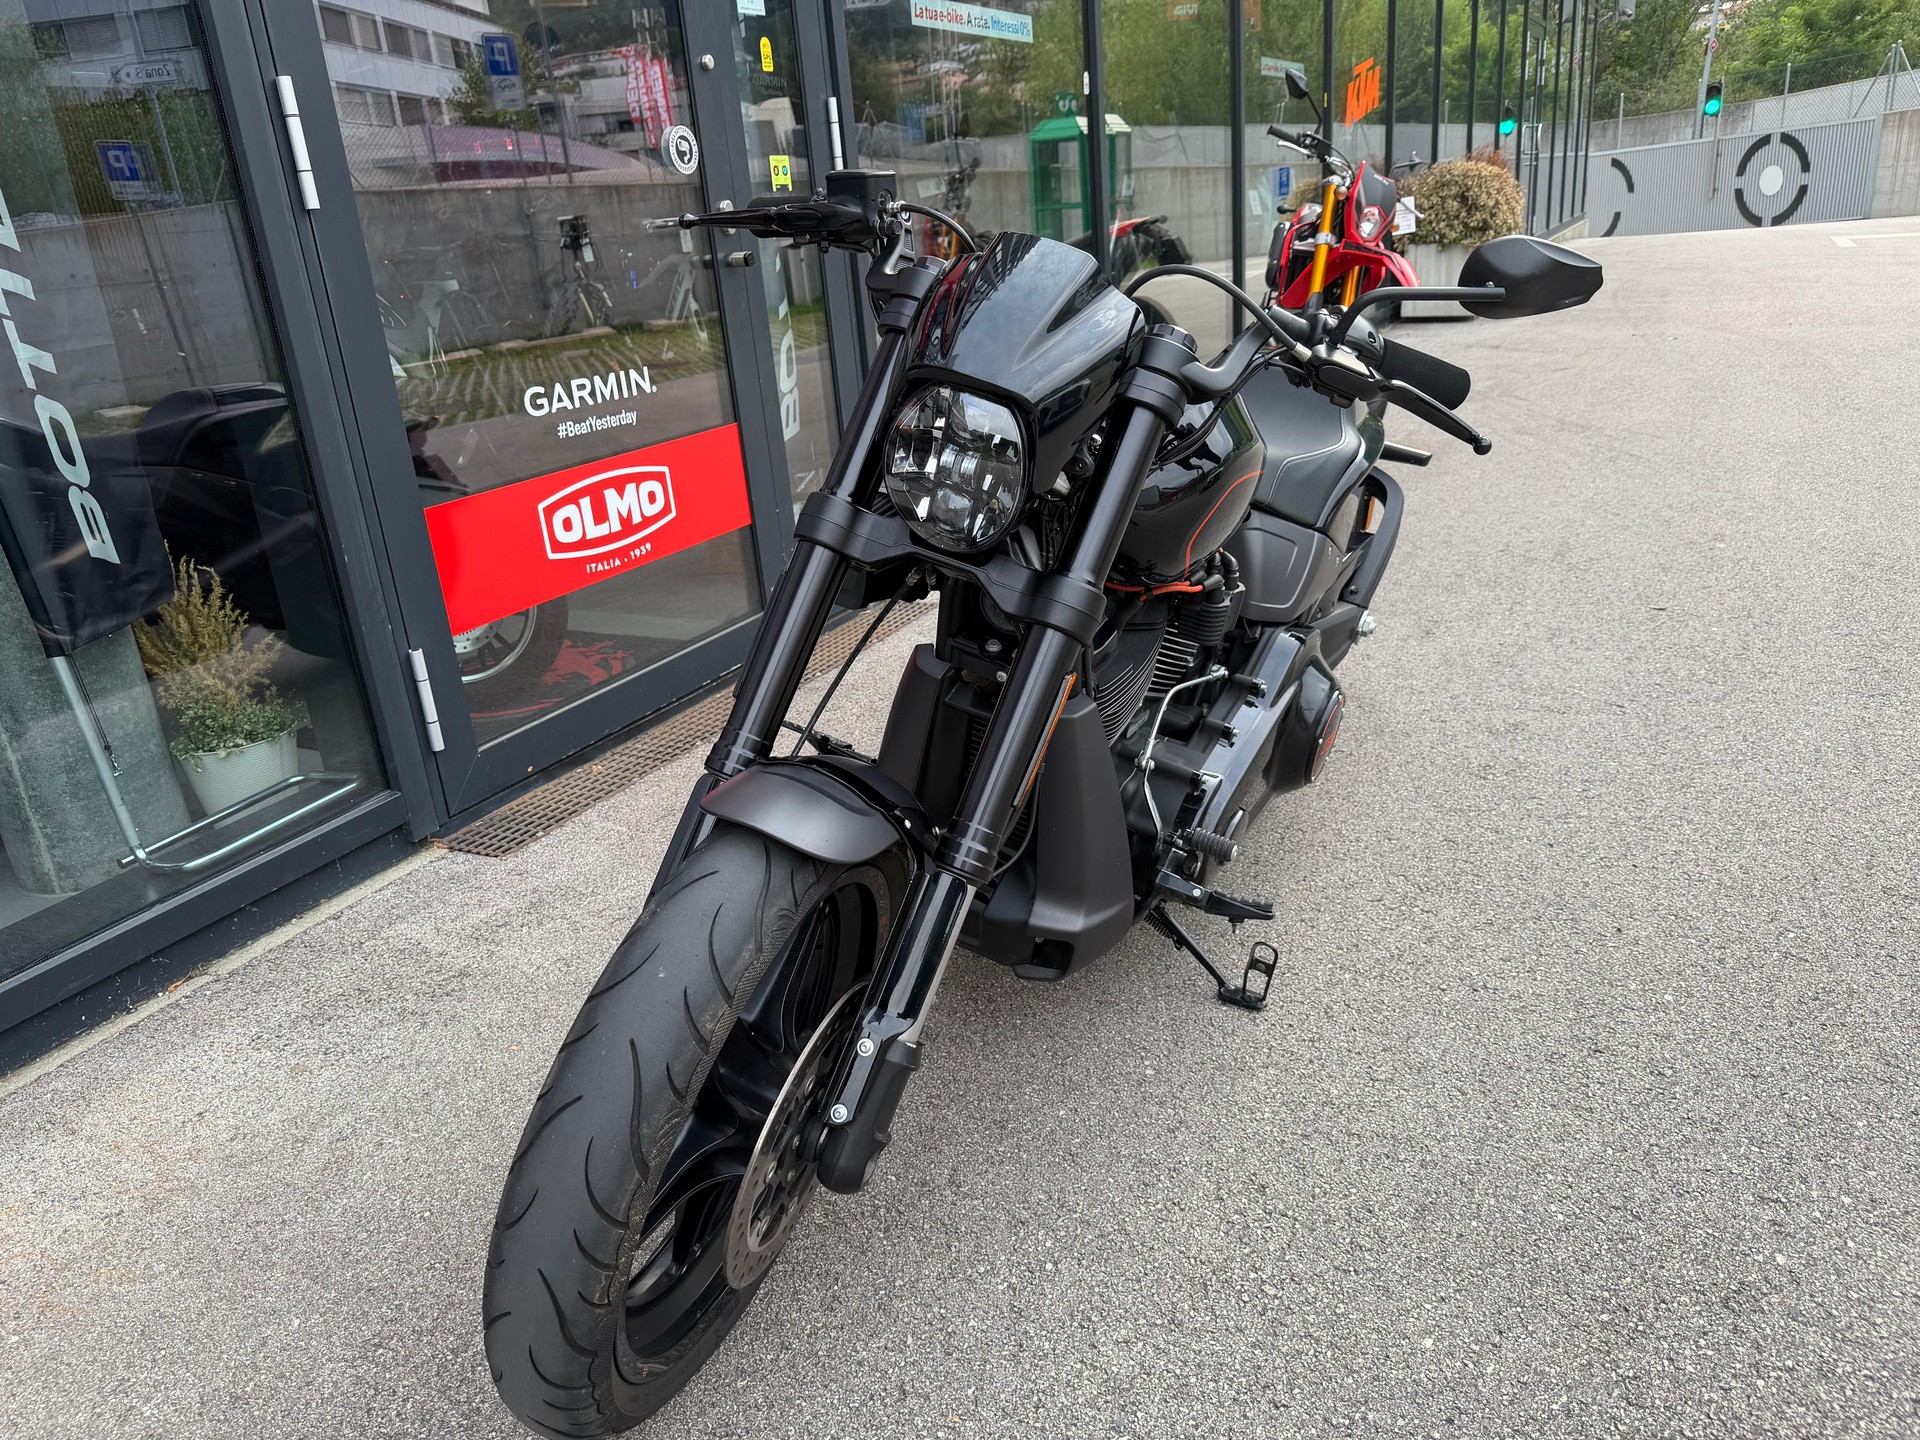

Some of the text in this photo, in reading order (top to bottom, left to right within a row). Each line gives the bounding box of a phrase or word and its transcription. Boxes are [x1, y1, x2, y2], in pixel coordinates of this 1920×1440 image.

[991, 16, 1020, 35] Interessi
[1345, 57, 1381, 128] KTM
[557, 409, 637, 439] #BeatYesterday
[552, 480, 665, 544] OLMO
[586, 542, 652, 574] ITALIA 1939
